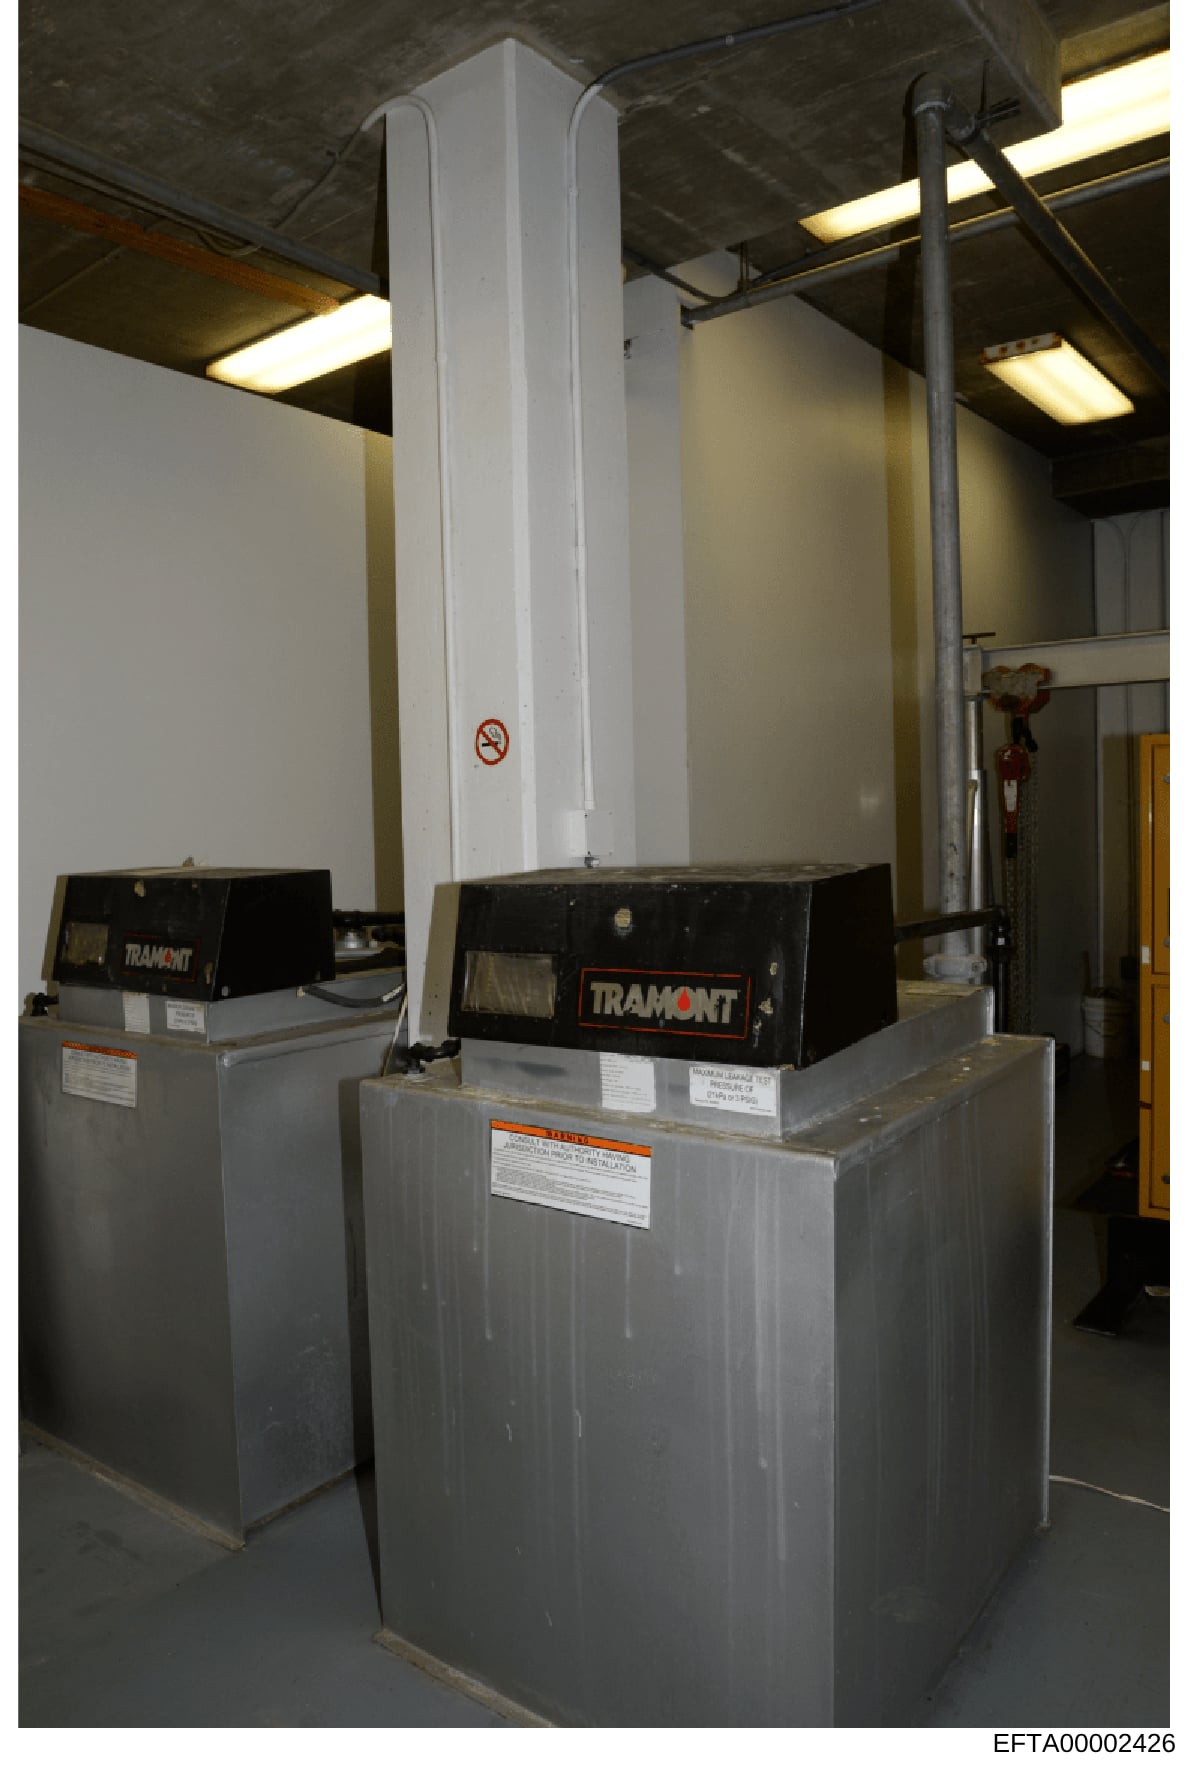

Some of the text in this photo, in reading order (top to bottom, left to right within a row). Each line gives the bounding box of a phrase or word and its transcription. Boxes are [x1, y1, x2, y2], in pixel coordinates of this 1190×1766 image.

[125, 943, 193, 972] TRAMONT
[590, 981, 738, 1024] TRAMONT
[692, 1067, 771, 1086] MAXIMUM LEAKAGE TEST
[709, 1080, 754, 1093] PRESSURE OF
[508, 1133, 630, 1163] CONSULT WITH AUTHORITY HAVING
[545, 1130, 589, 1144] WARNING
[504, 1142, 637, 1173] JURISDICTION PRIOR TO INSTALLATION
